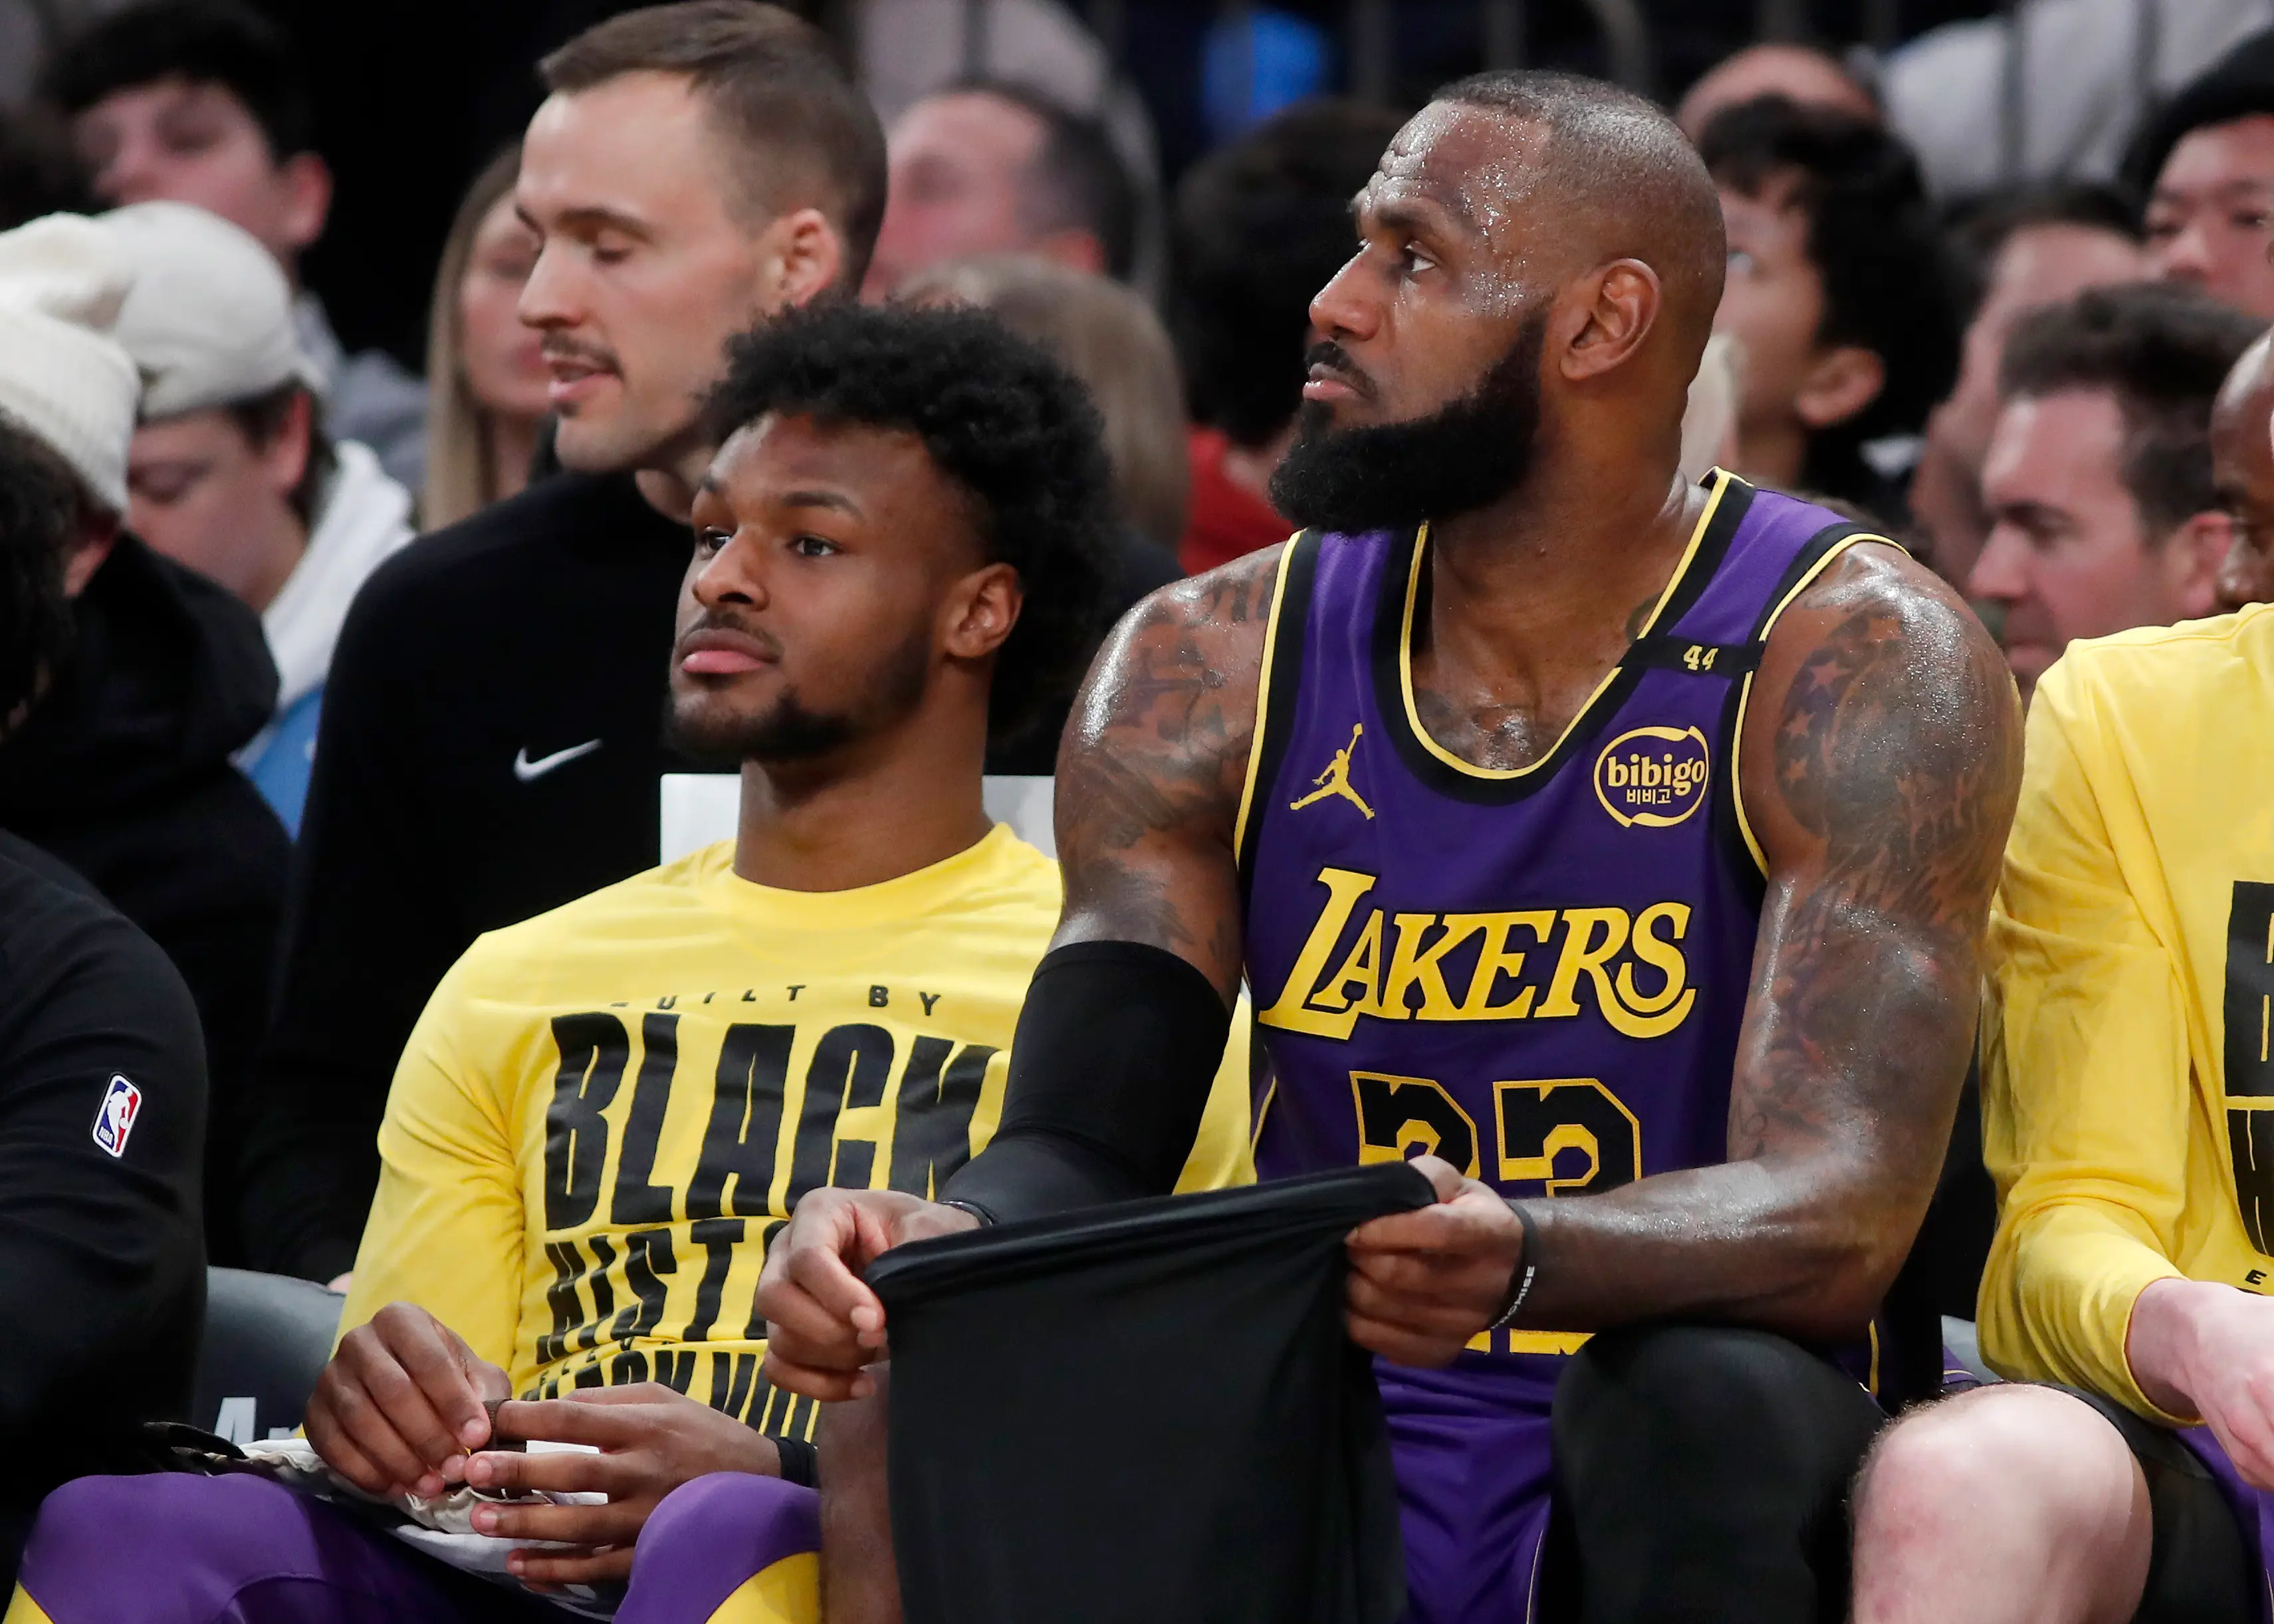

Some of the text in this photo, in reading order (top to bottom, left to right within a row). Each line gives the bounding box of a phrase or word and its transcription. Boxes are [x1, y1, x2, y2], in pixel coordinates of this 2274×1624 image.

[1683, 645, 1719, 671] 44
[1607, 753, 1706, 796] bibigo
[1626, 788, 1672, 805] 비비고
[1256, 866, 1698, 1040] LAKERS
[610, 985, 941, 1016] UILT BY
[98, 1126, 114, 1145] NBA
[544, 1012, 1002, 1231] BLACK
[534, 1218, 791, 1365] HIST
